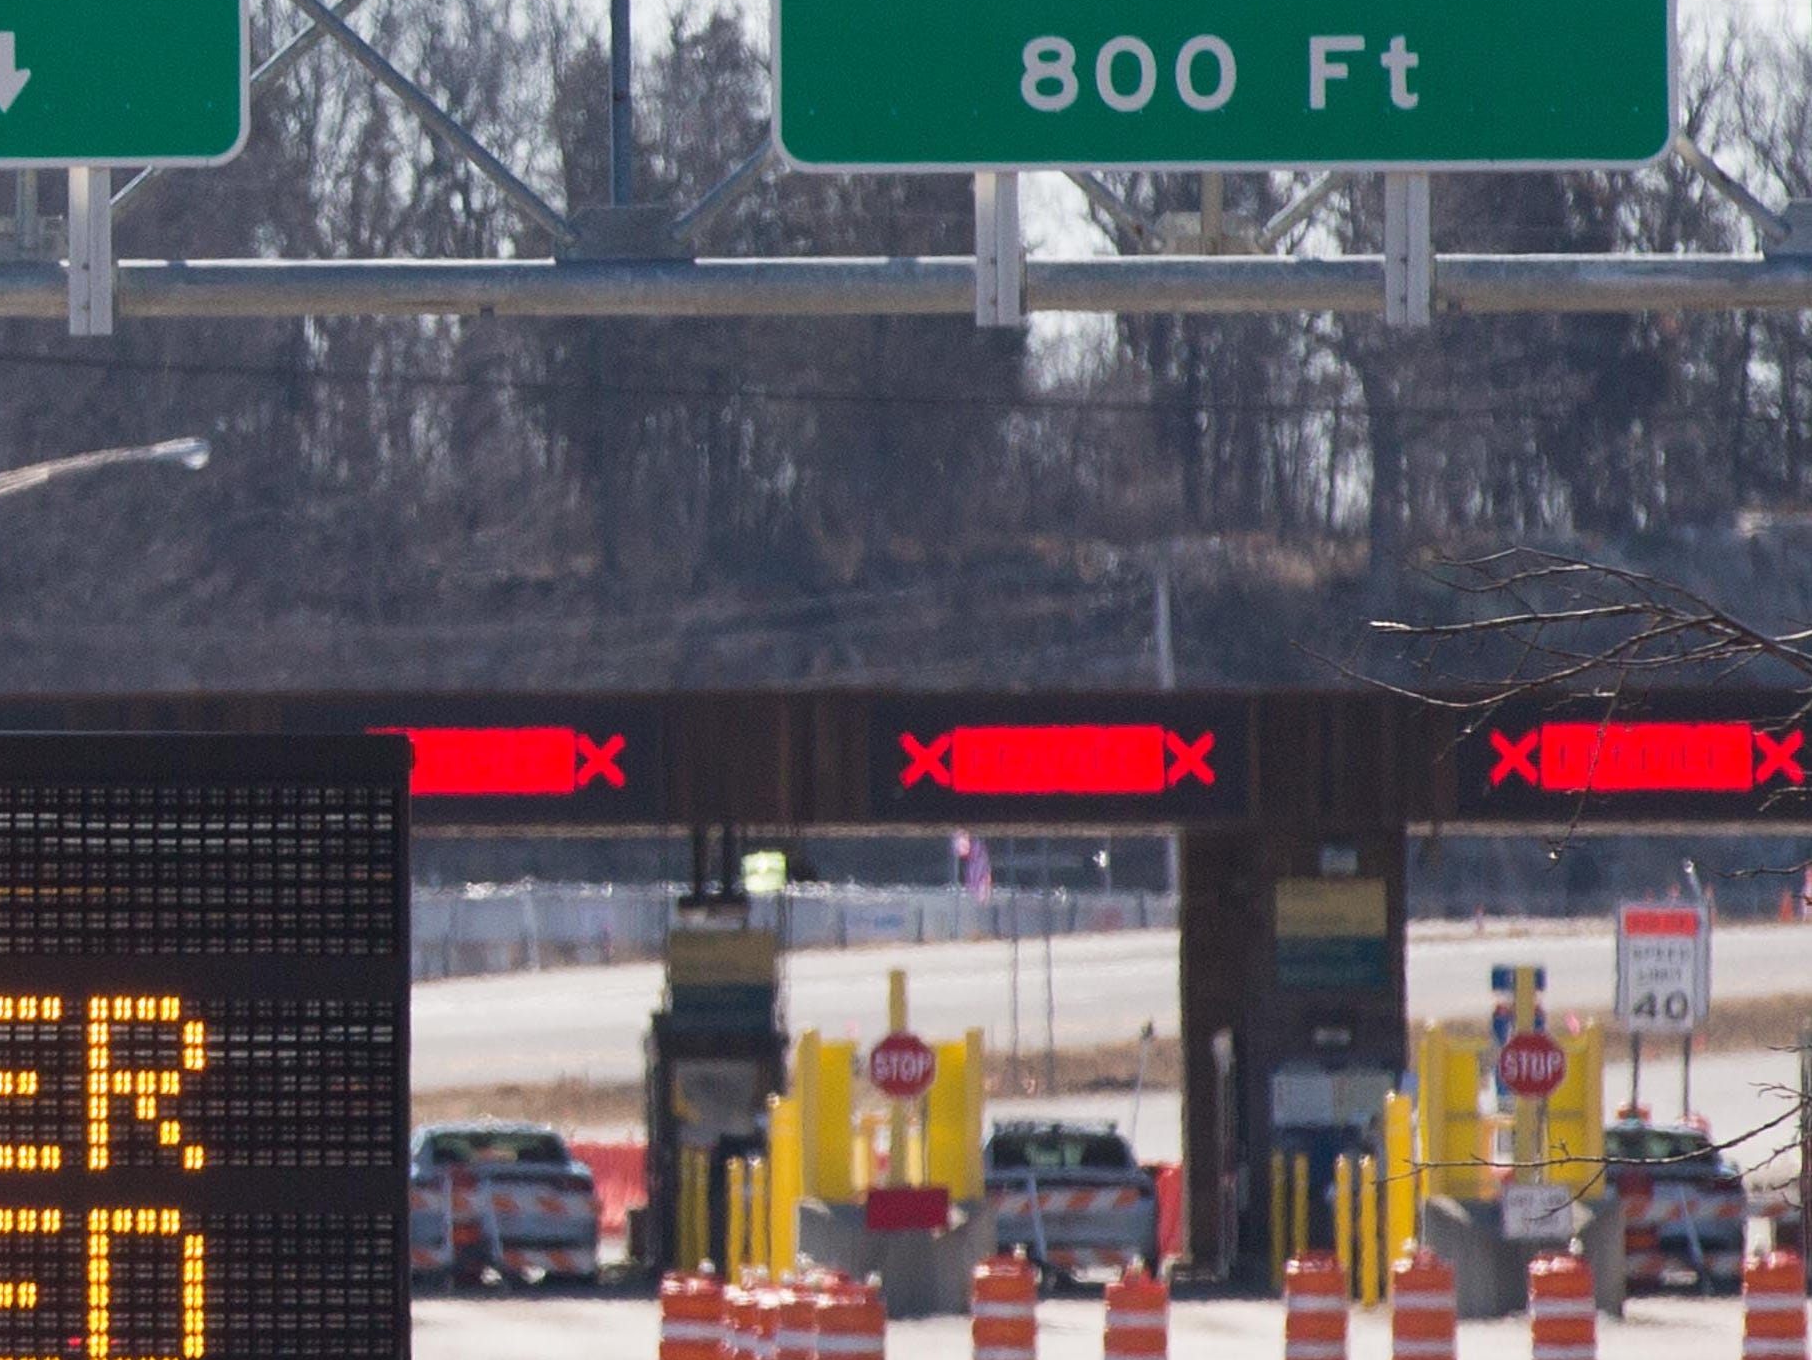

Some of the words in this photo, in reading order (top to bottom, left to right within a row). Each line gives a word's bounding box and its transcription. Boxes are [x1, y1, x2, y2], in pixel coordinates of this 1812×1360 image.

[1020, 35, 1237, 112] 800
[1309, 34, 1420, 109] Ft
[1632, 991, 1689, 1020] 40
[875, 1050, 932, 1082] STOP
[1503, 1050, 1562, 1082] STOP
